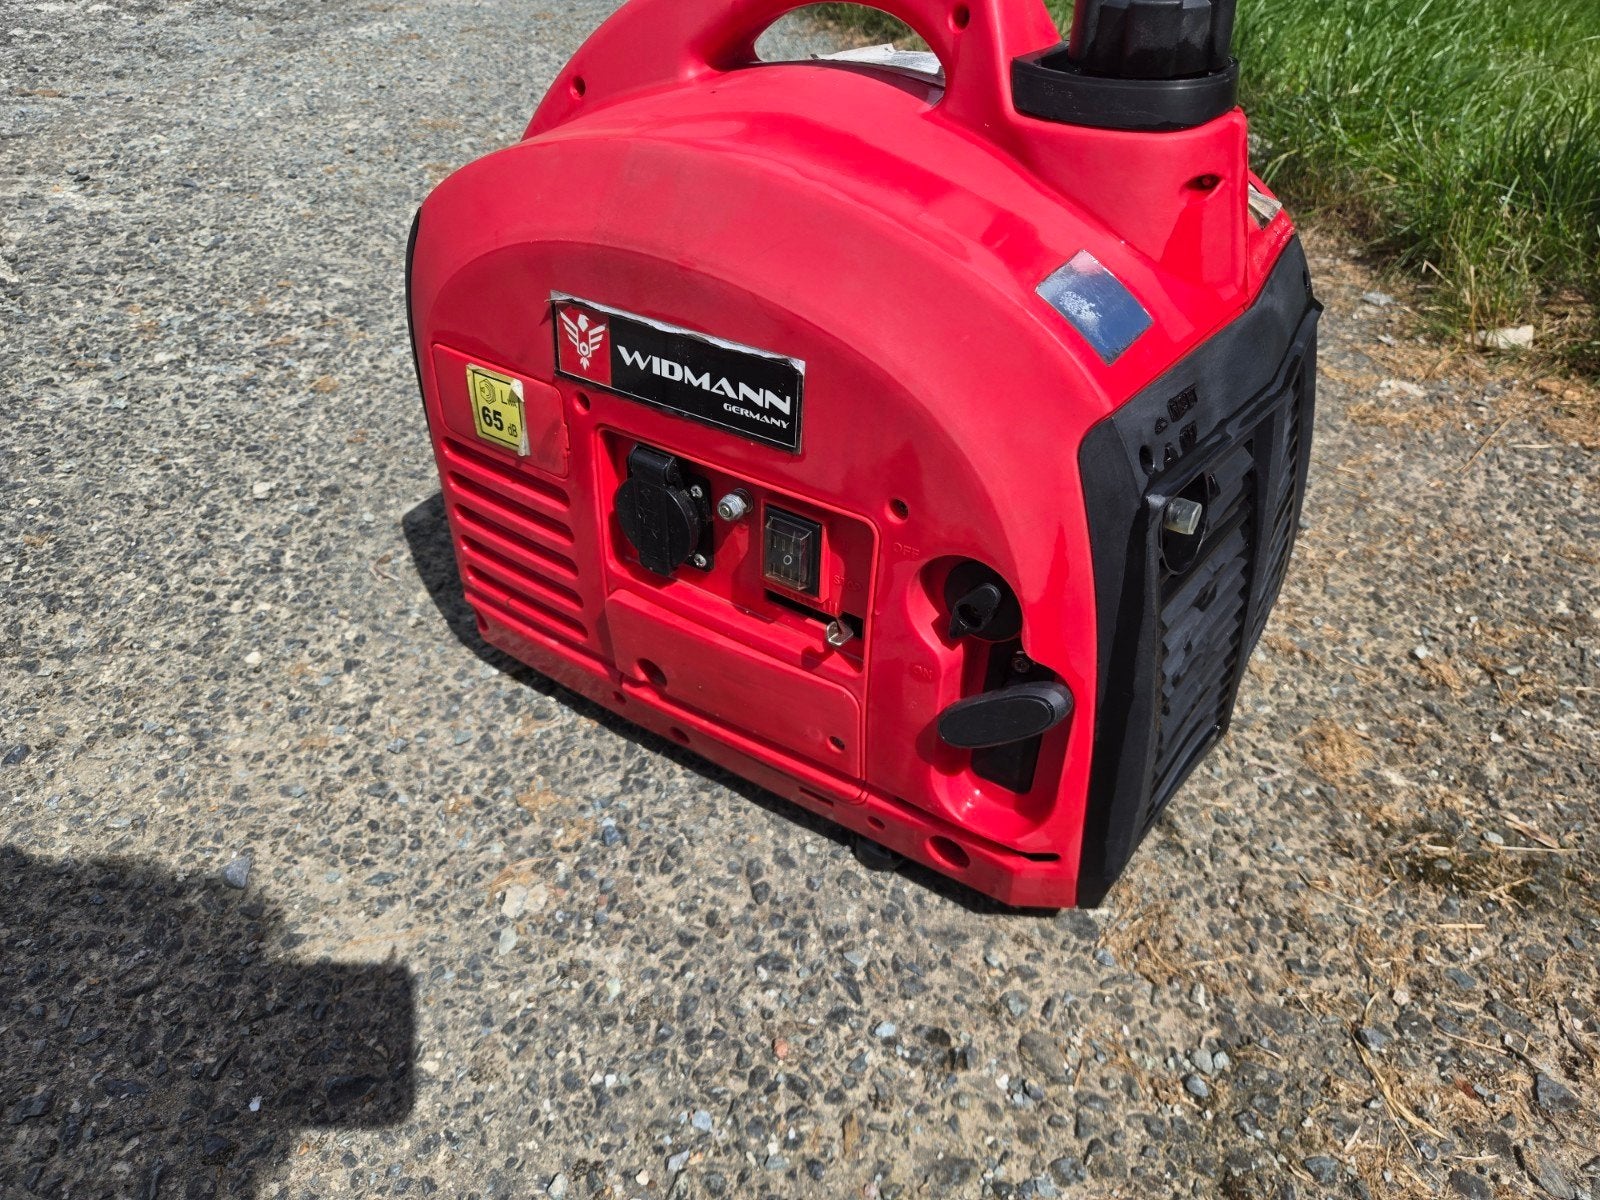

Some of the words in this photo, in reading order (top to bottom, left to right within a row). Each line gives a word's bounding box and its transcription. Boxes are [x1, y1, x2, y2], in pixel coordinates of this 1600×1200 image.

[617, 345, 790, 415] WIDMANN
[481, 406, 504, 431] 65
[723, 402, 790, 429] GERMANY
[507, 423, 518, 437] dB
